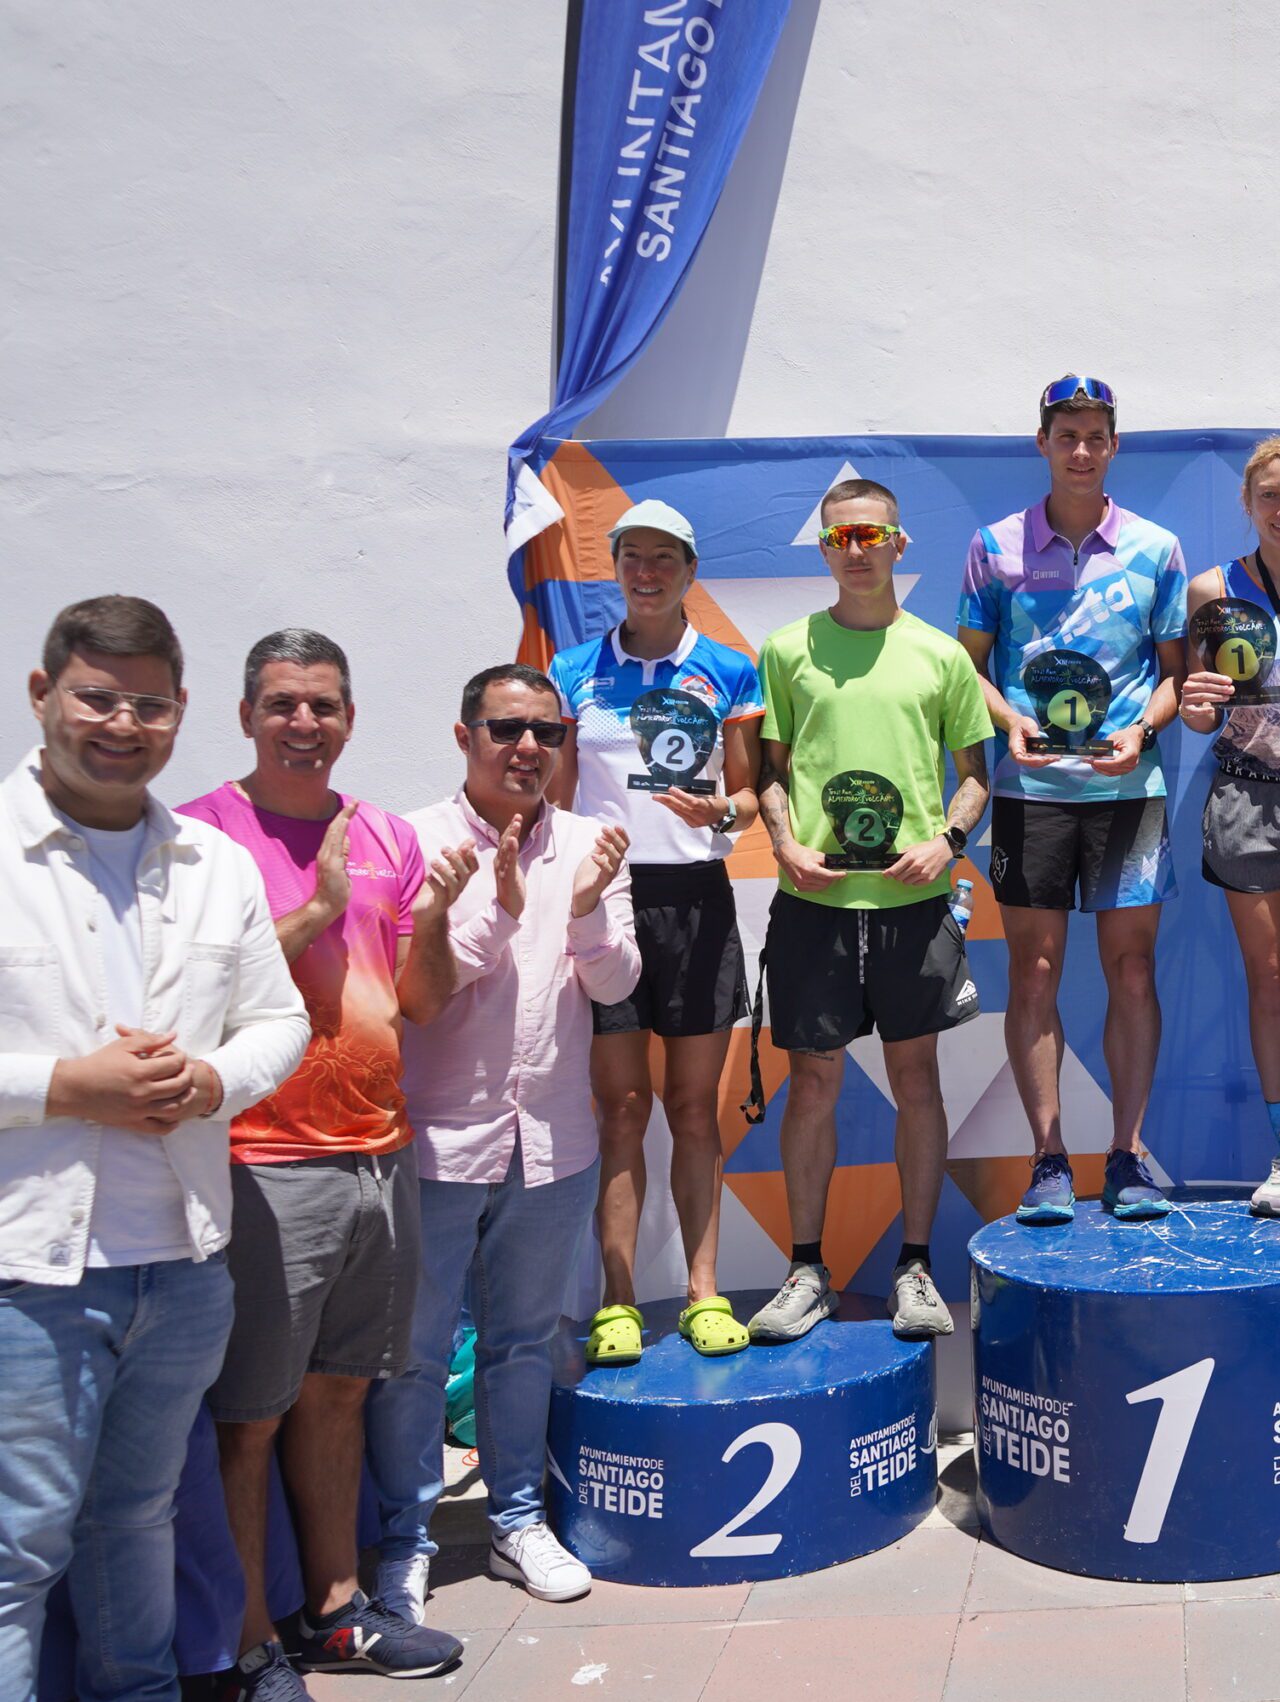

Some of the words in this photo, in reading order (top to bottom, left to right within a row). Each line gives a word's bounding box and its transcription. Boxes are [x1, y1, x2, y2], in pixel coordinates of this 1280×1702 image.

[636, 16, 715, 262] SANTIAGO
[1231, 644, 1245, 674] 1
[1064, 696, 1077, 725] 1
[666, 735, 685, 764] 2
[858, 813, 875, 841] 2
[982, 1393, 1070, 1443] SANTIAGO
[849, 1426, 916, 1469] SANTIAGO
[983, 1422, 991, 1456] DEL
[992, 1423, 1070, 1483] TEIDE
[1123, 1357, 1215, 1544] 1
[579, 1459, 664, 1490] SANTIAGO
[689, 1422, 802, 1557] 2
[850, 1470, 861, 1497] DEL
[862, 1444, 917, 1491] TEIDE
[579, 1480, 588, 1504] DEL
[589, 1481, 663, 1519] TEIDE
